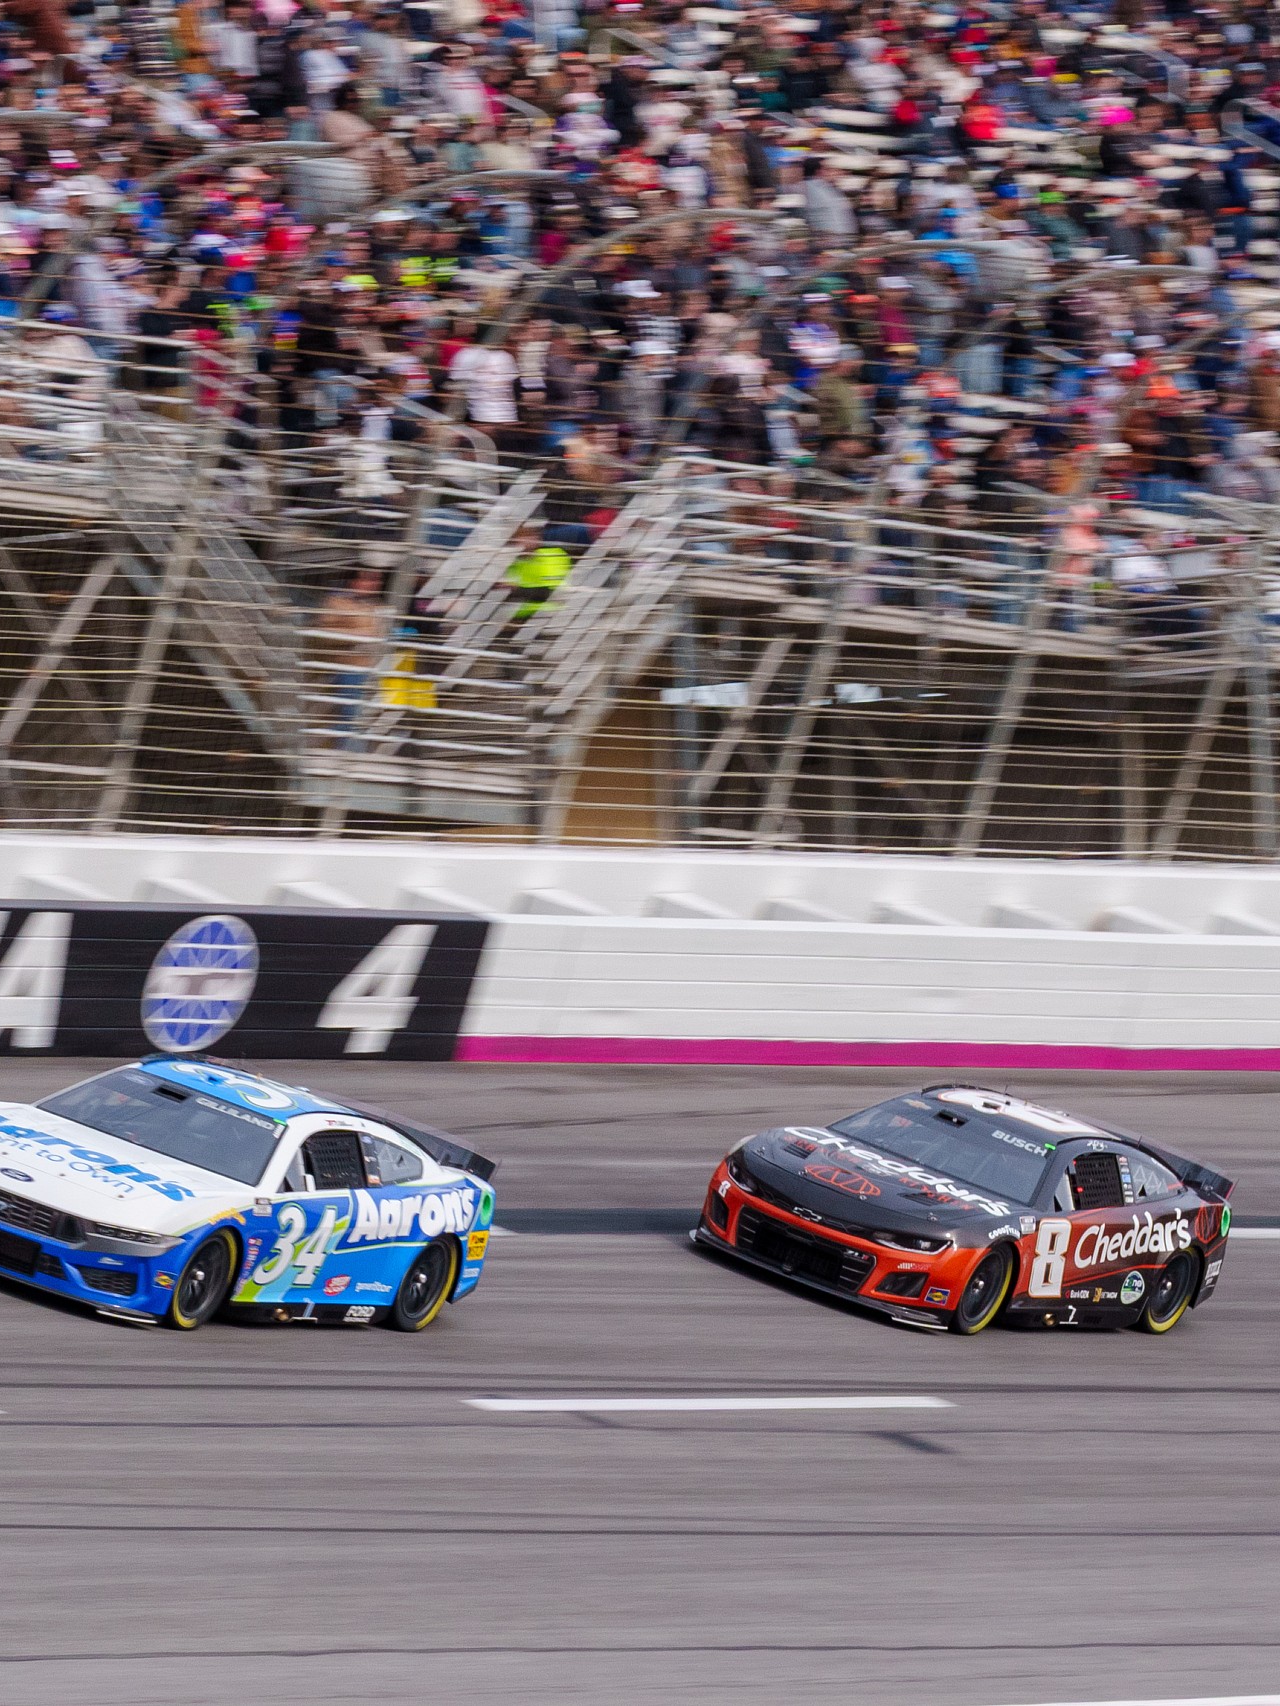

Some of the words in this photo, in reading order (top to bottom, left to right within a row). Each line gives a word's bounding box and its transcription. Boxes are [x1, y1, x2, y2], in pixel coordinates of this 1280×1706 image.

[317, 924, 438, 1053] 4
[36, 1149, 65, 1162] to
[69, 1161, 135, 1193] Own
[991, 1130, 1047, 1157] BUSCH
[252, 1203, 338, 1288] 34
[347, 1188, 474, 1243] Aaron's
[1074, 1208, 1192, 1269] Cheddar's
[1028, 1218, 1072, 1298] 8
